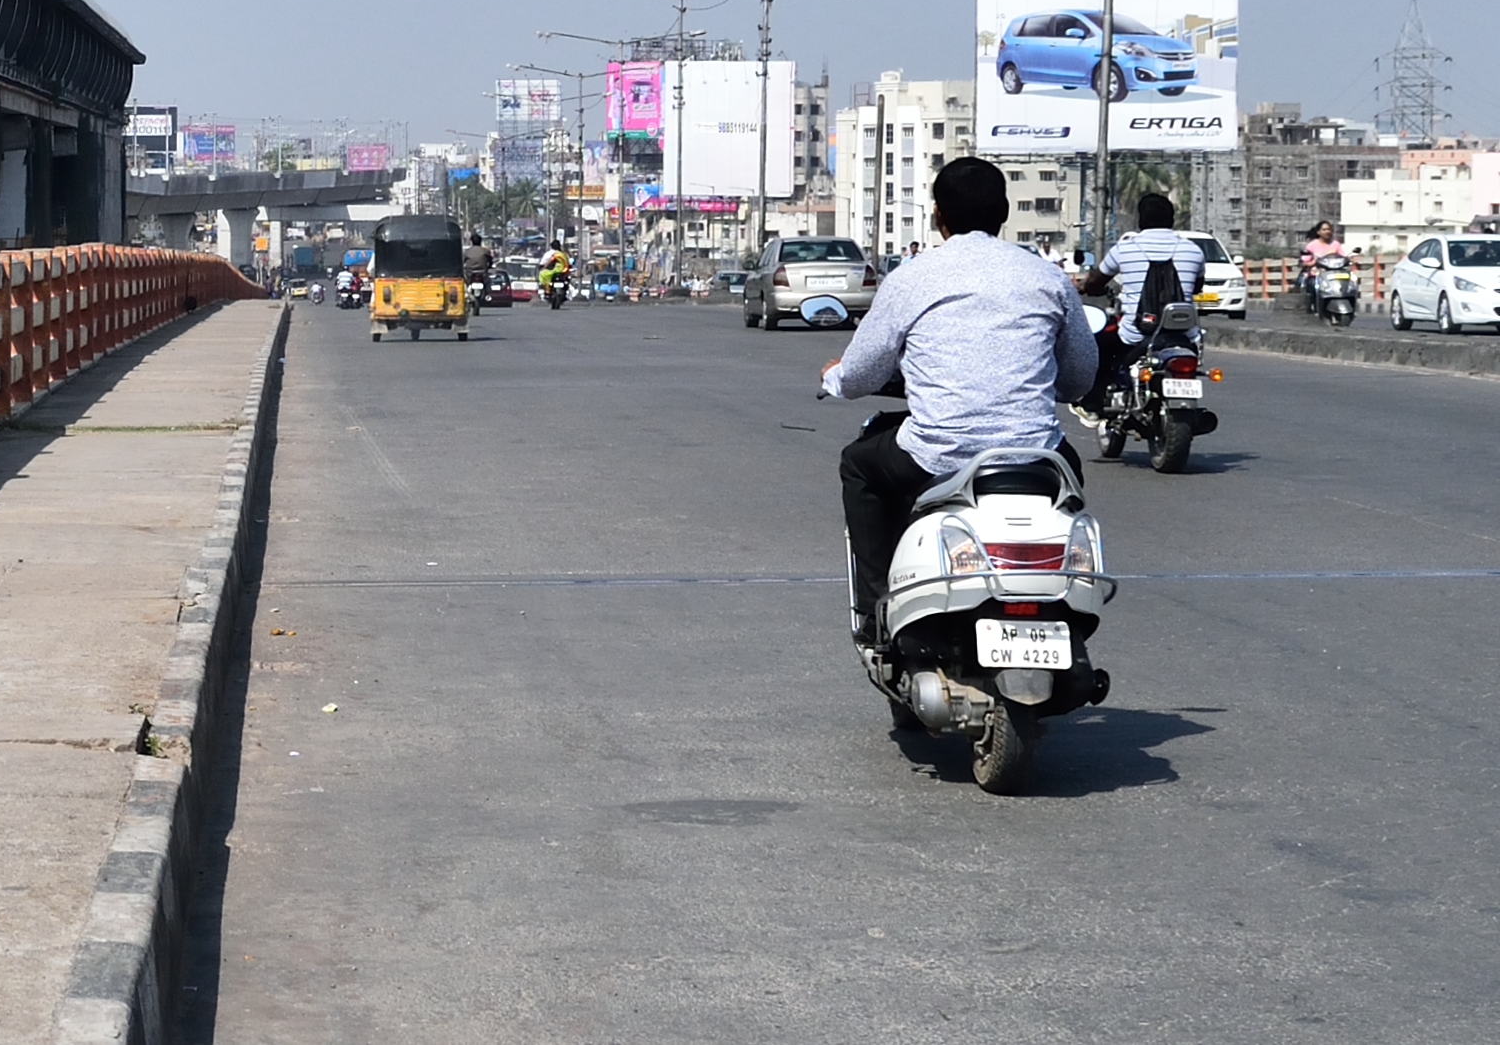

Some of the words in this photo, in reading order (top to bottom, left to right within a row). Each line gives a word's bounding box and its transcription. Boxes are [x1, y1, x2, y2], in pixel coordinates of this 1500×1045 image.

[1129, 116, 1223, 130] ERTIGA
[1001, 627, 1018, 642] AP
[1030, 628, 1046, 643] 09
[990, 649, 1012, 663] CW
[1023, 649, 1060, 664] 4229
